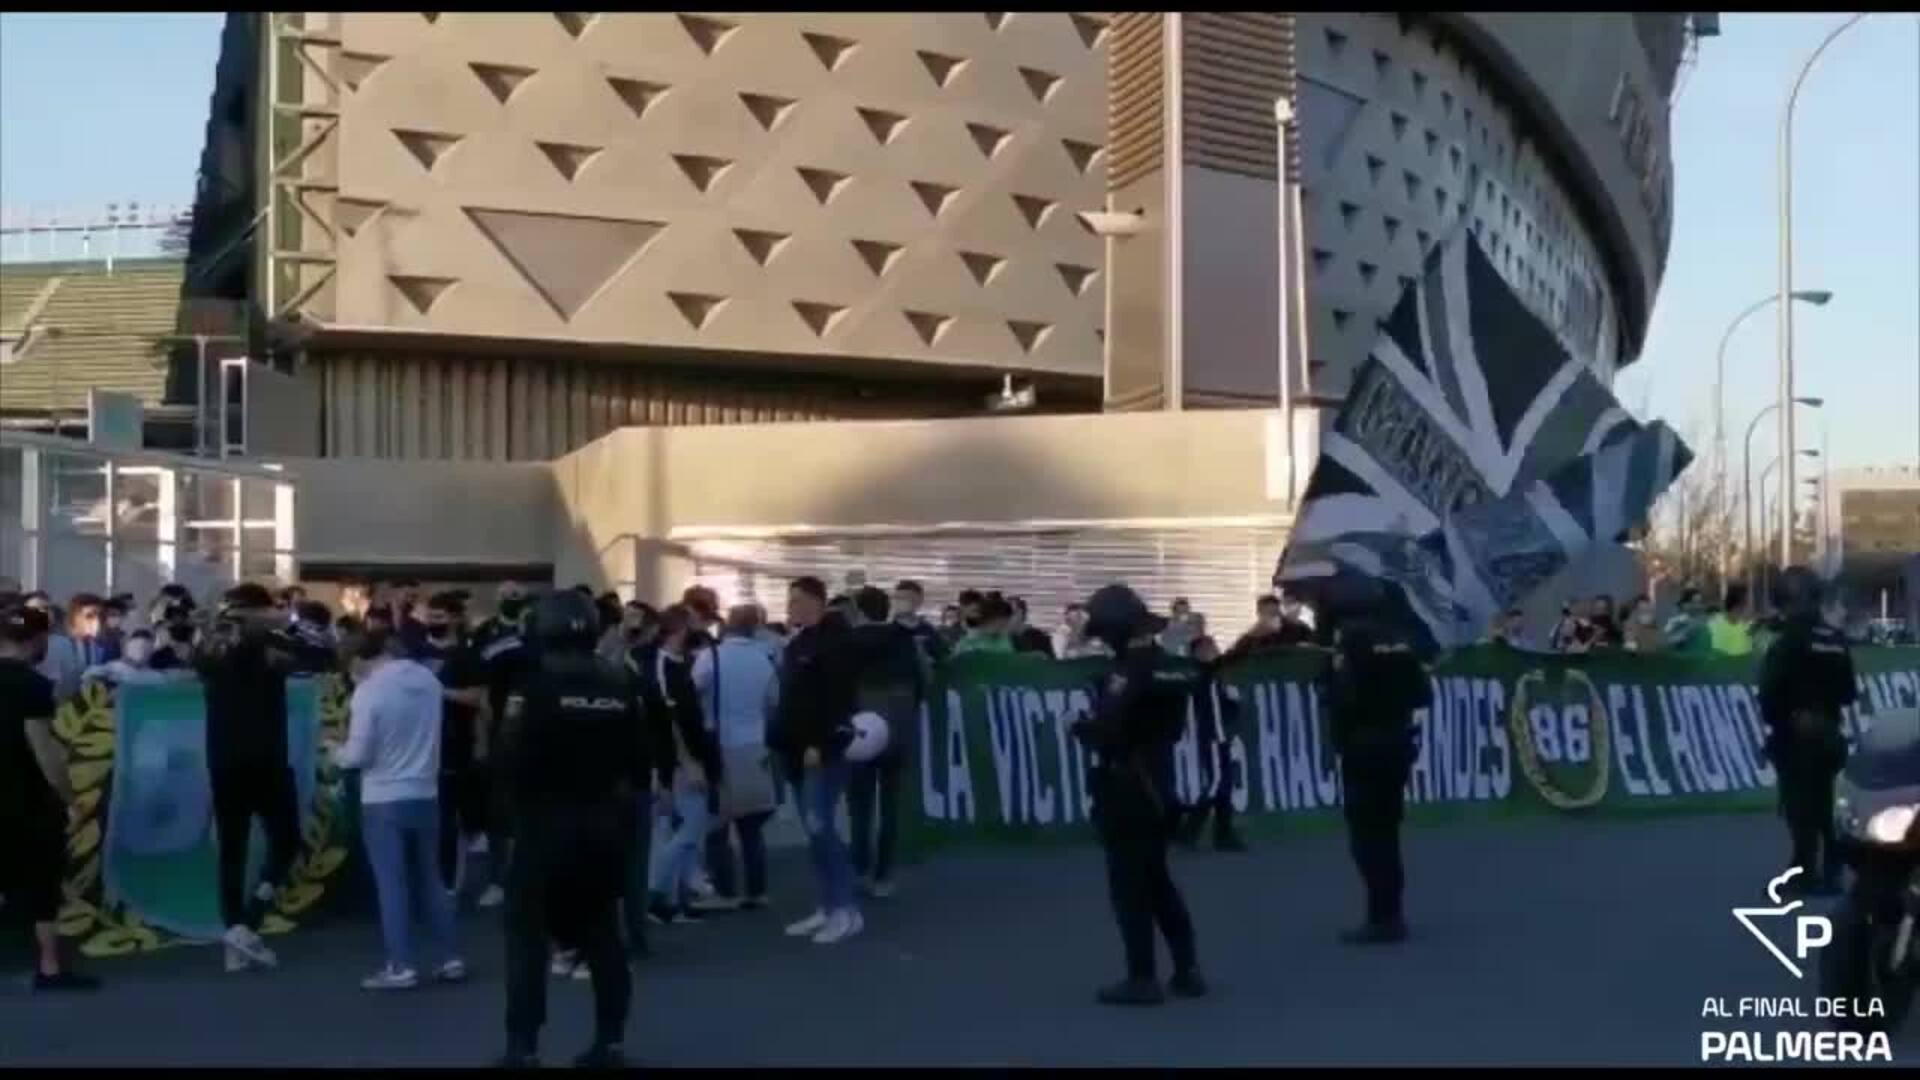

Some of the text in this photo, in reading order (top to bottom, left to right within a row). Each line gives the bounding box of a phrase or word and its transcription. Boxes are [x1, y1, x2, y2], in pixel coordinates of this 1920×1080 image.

[921, 690, 974, 823] LA
[985, 686, 1100, 824] VICTO
[1404, 675, 1511, 803] ANDES
[1530, 703, 1590, 763] 86
[1608, 683, 1672, 795] EL
[1657, 684, 1778, 793] HONO
